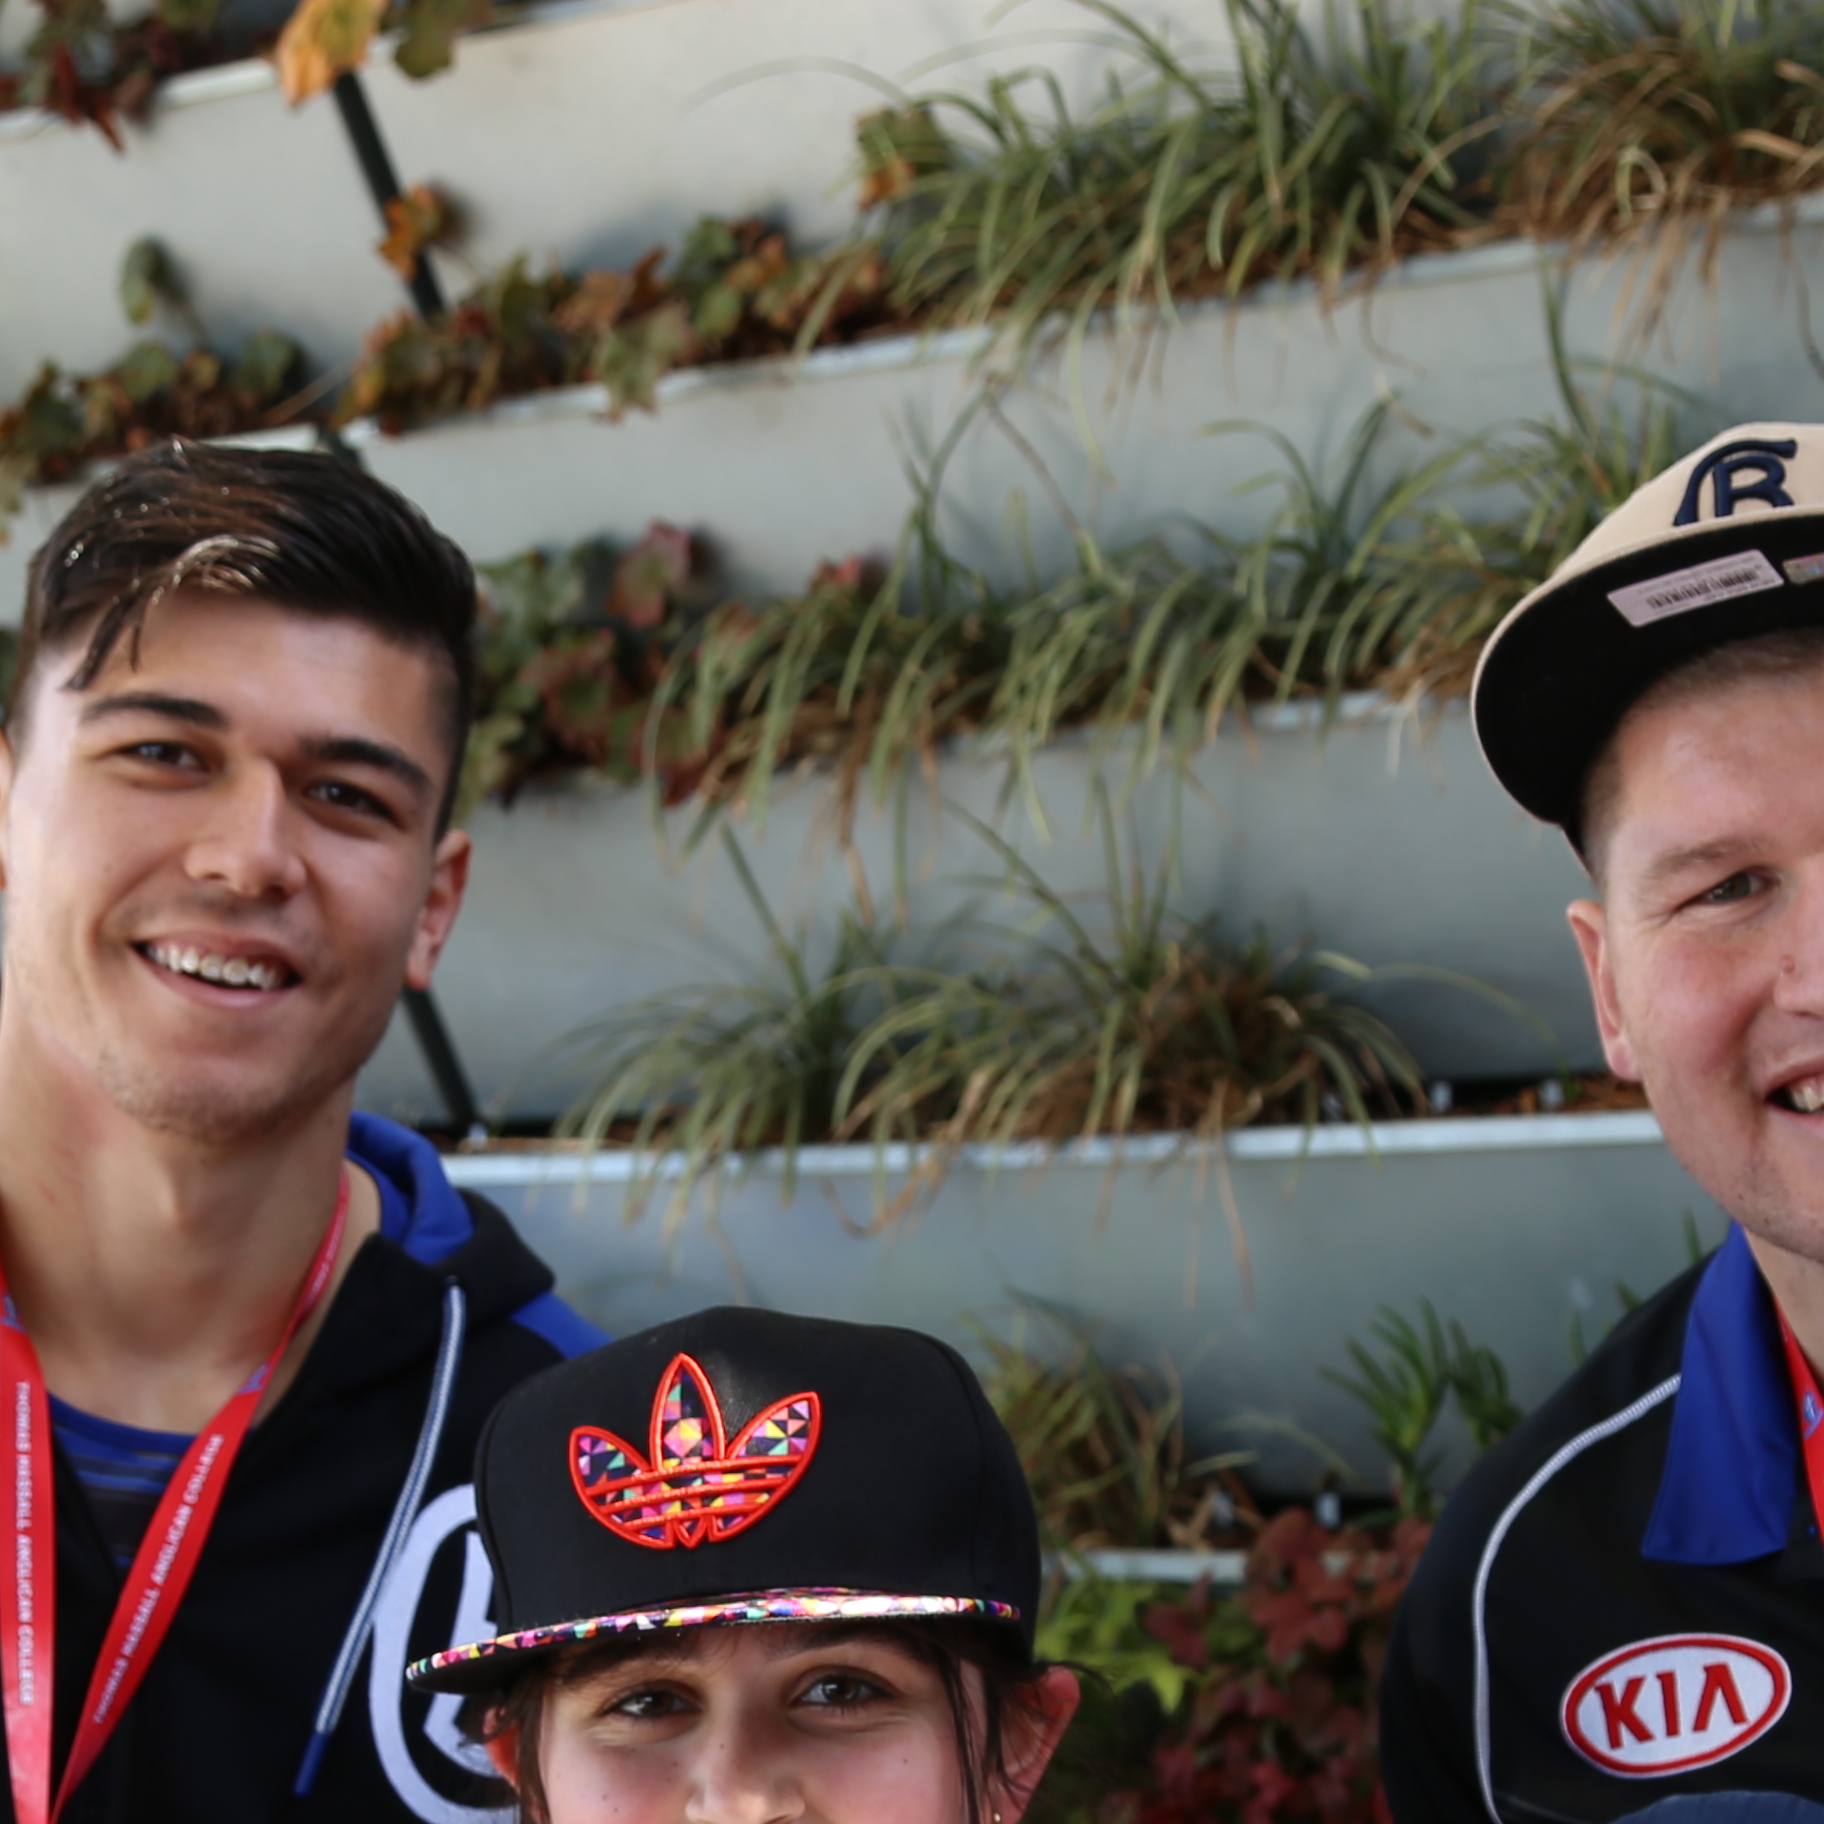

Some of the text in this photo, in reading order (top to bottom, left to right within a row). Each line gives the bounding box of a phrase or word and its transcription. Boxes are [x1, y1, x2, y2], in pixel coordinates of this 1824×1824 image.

[15, 1381, 32, 1452] THOMAS
[150, 1503, 194, 1586] ANGLICAN
[183, 1433, 225, 1504] COLLEGE
[16, 1533, 34, 1622] ANGLICAN
[17, 1623, 34, 1706] COLLEGE
[1595, 1663, 1748, 1749] KIA
